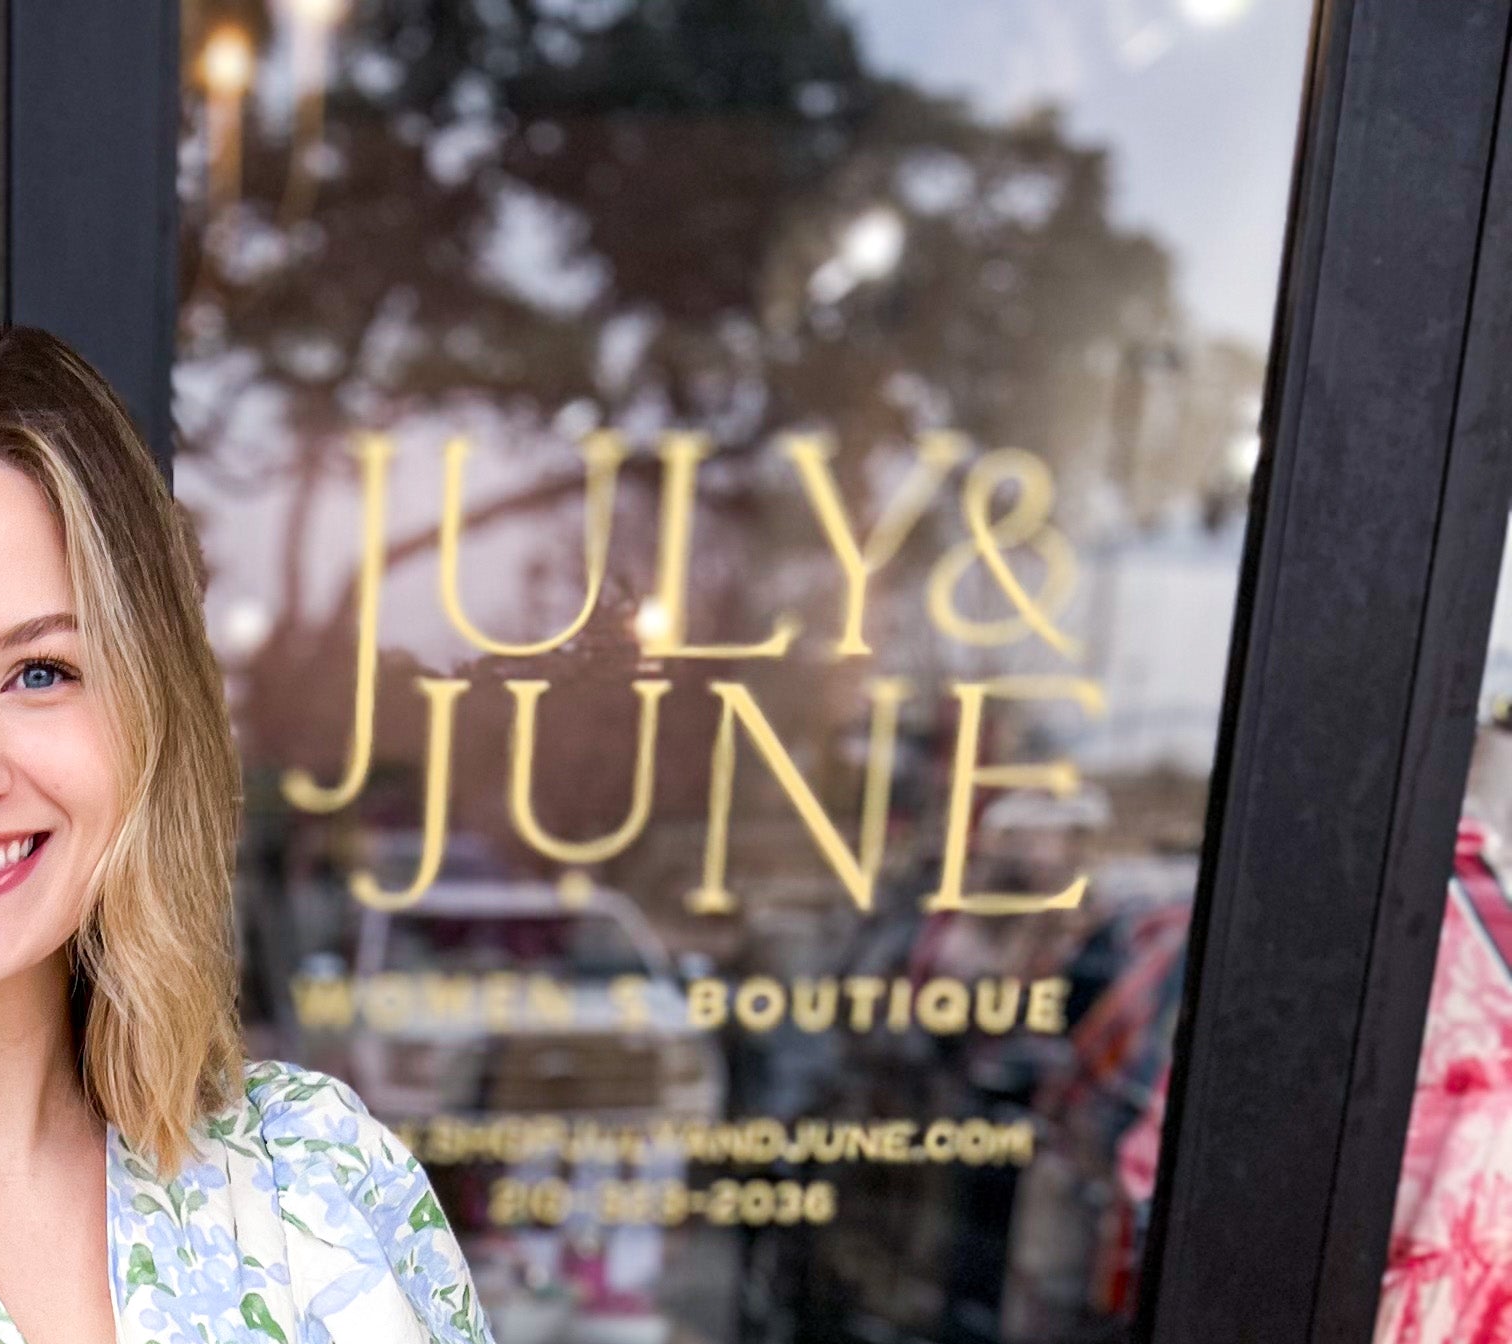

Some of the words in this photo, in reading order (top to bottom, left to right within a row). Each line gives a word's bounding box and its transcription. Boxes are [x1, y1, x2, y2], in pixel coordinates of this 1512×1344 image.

[350, 674, 1108, 914] JUNE
[292, 972, 652, 1031] WOMENS
[686, 974, 1071, 1036] BOUTIQUE
